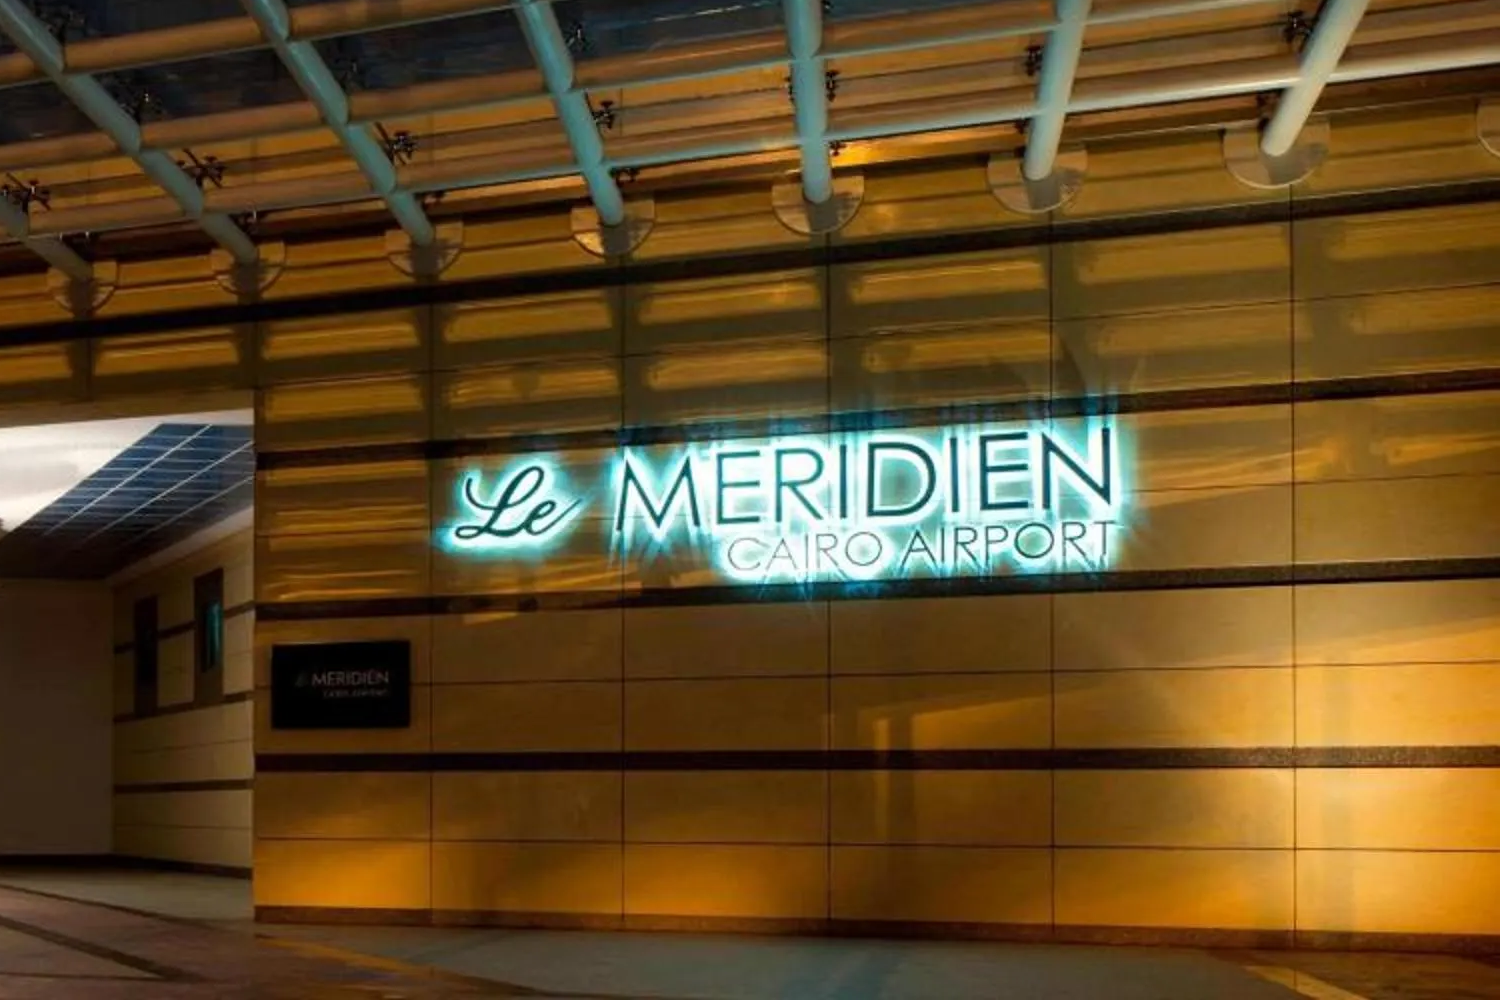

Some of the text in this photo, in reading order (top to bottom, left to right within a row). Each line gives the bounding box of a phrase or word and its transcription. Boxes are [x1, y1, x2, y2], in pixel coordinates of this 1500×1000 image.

[454, 426, 1112, 541] Le MERIDIEN
[727, 519, 1116, 572] CAIRO AIRPORT
